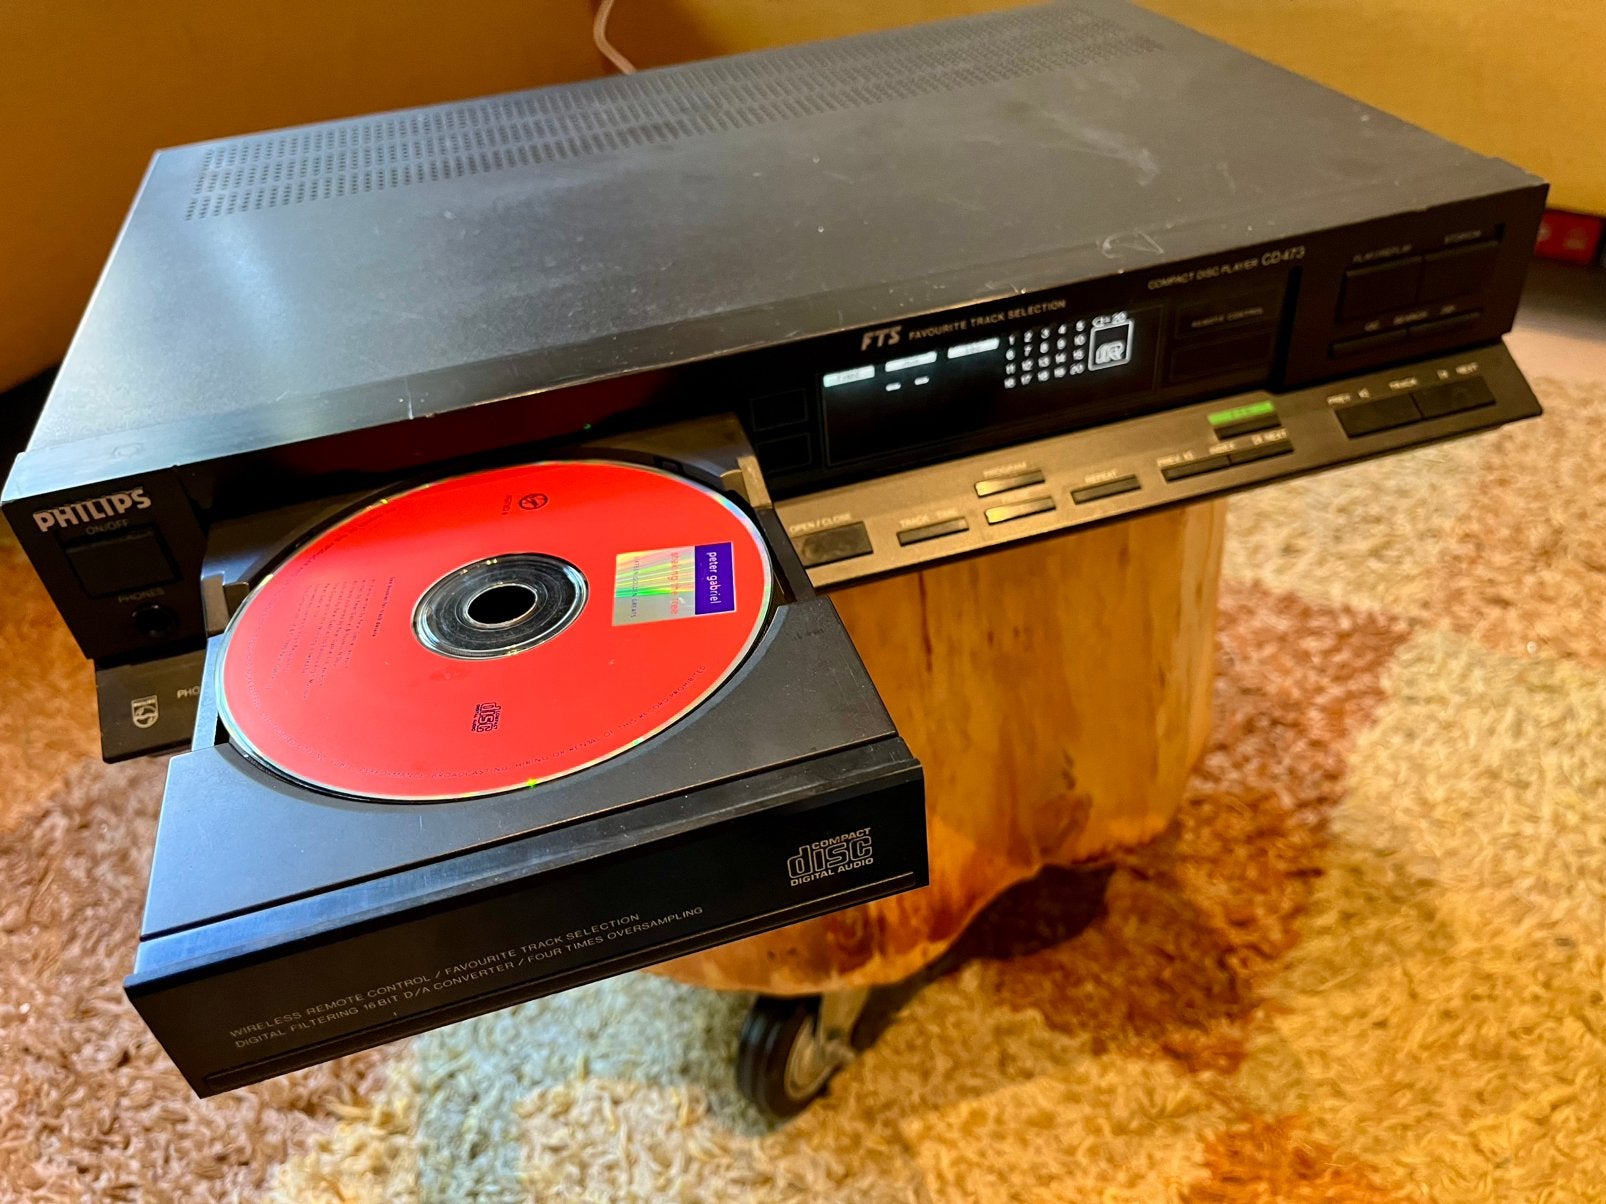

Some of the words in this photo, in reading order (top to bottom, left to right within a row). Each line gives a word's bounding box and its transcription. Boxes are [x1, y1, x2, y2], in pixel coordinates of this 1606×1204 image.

[861, 326, 902, 351] FTS
[909, 319, 967, 341] FAVOURITE
[970, 311, 1005, 327] TRACK
[1007, 300, 1066, 320] SELECTION
[32, 486, 151, 533] PHILIPS
[85, 518, 129, 536] ON/OFF
[706, 551, 718, 573] peter
[706, 574, 722, 604] gabriel
[811, 827, 871, 849] COMPACT
[787, 835, 873, 879] disc
[790, 869, 835, 887] DIGITAL
[837, 857, 874, 873] AUDIO
[230, 1012, 302, 1038] WIRELESS
[306, 993, 364, 1016] REMOTE
[367, 974, 431, 998] CONTROL
[445, 949, 517, 975] FAVOURITE
[521, 935, 564, 953] TRACK
[566, 913, 640, 941] SELECTION
[235, 1029, 287, 1048] DIGITAL
[290, 1007, 359, 1032] FILTERING
[363, 1001, 377, 1011] 16
[377, 995, 398, 1007] BIT
[403, 987, 431, 1000] D/A
[433, 961, 515, 990] CONVERTER
[528, 947, 562, 963] FOUR
[566, 935, 604, 951] TIMES
[607, 906, 703, 940] OVERSAMPLING
